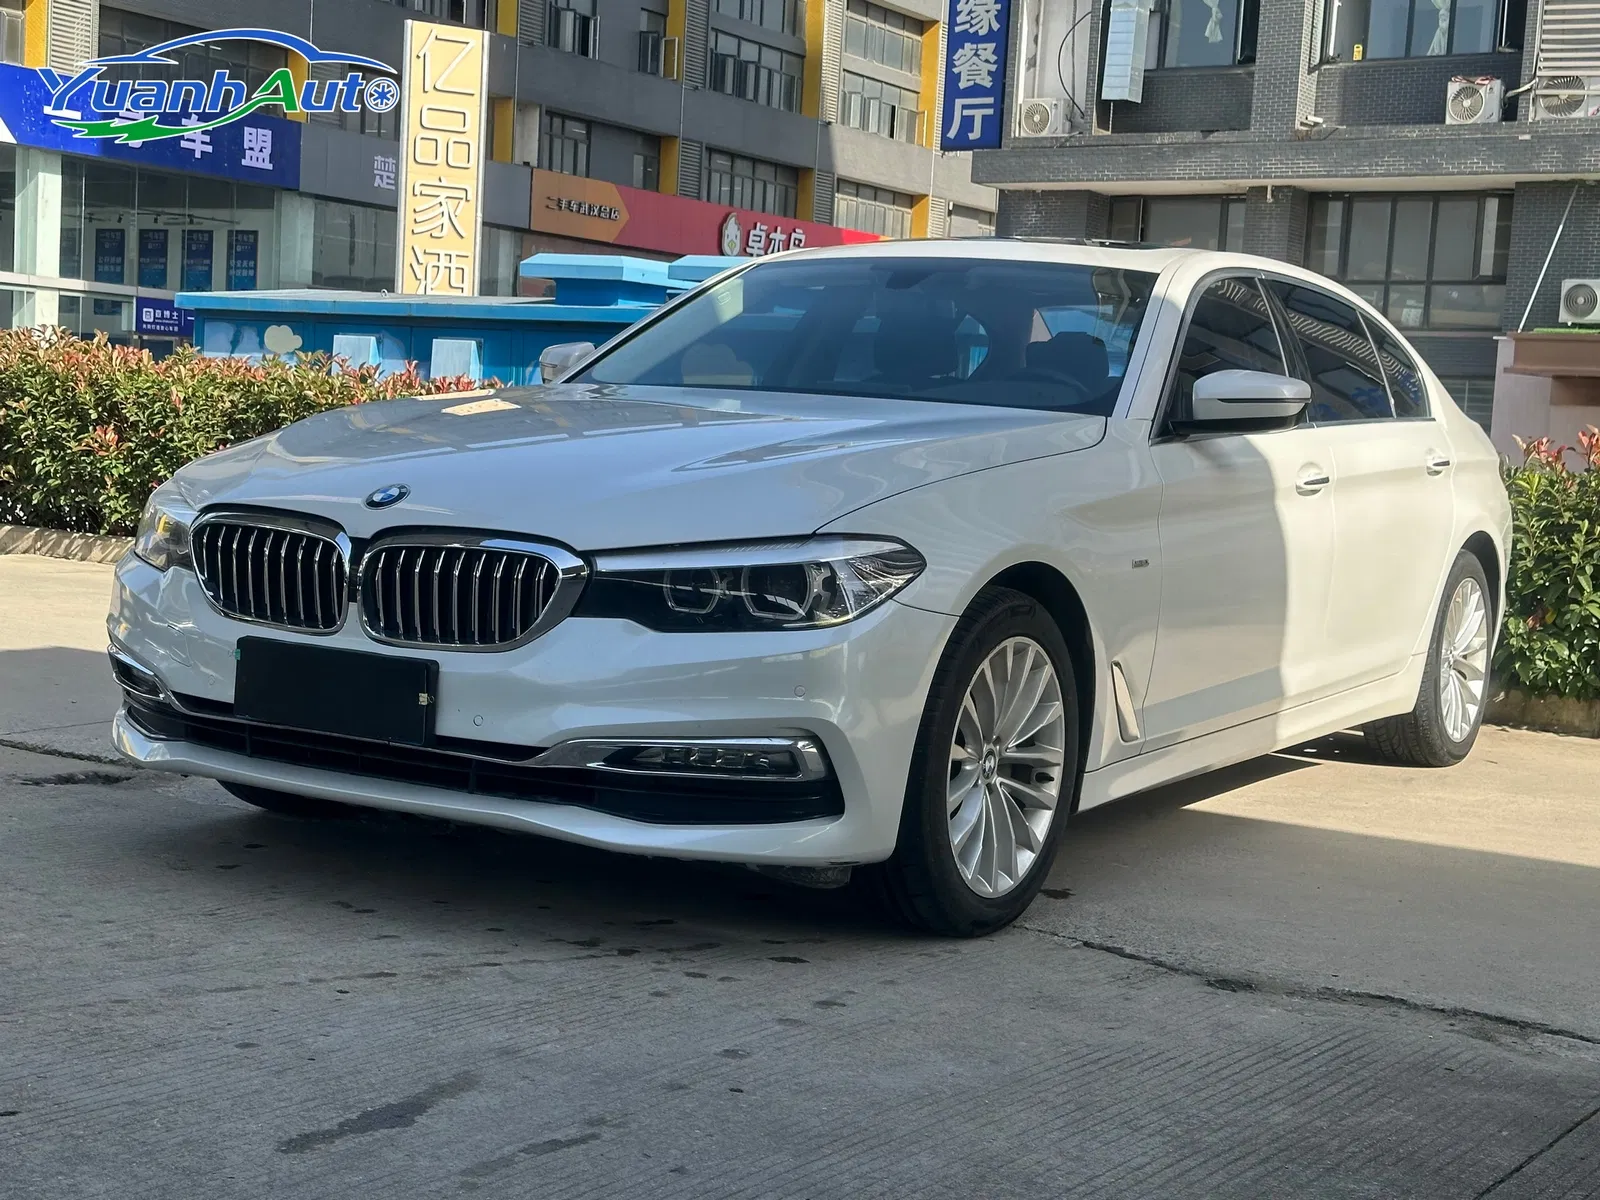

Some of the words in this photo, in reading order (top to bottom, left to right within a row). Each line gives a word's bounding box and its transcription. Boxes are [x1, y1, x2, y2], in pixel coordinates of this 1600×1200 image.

[947, 0, 1001, 140] 缘餐厅
[373, 155, 396, 190] 楚
